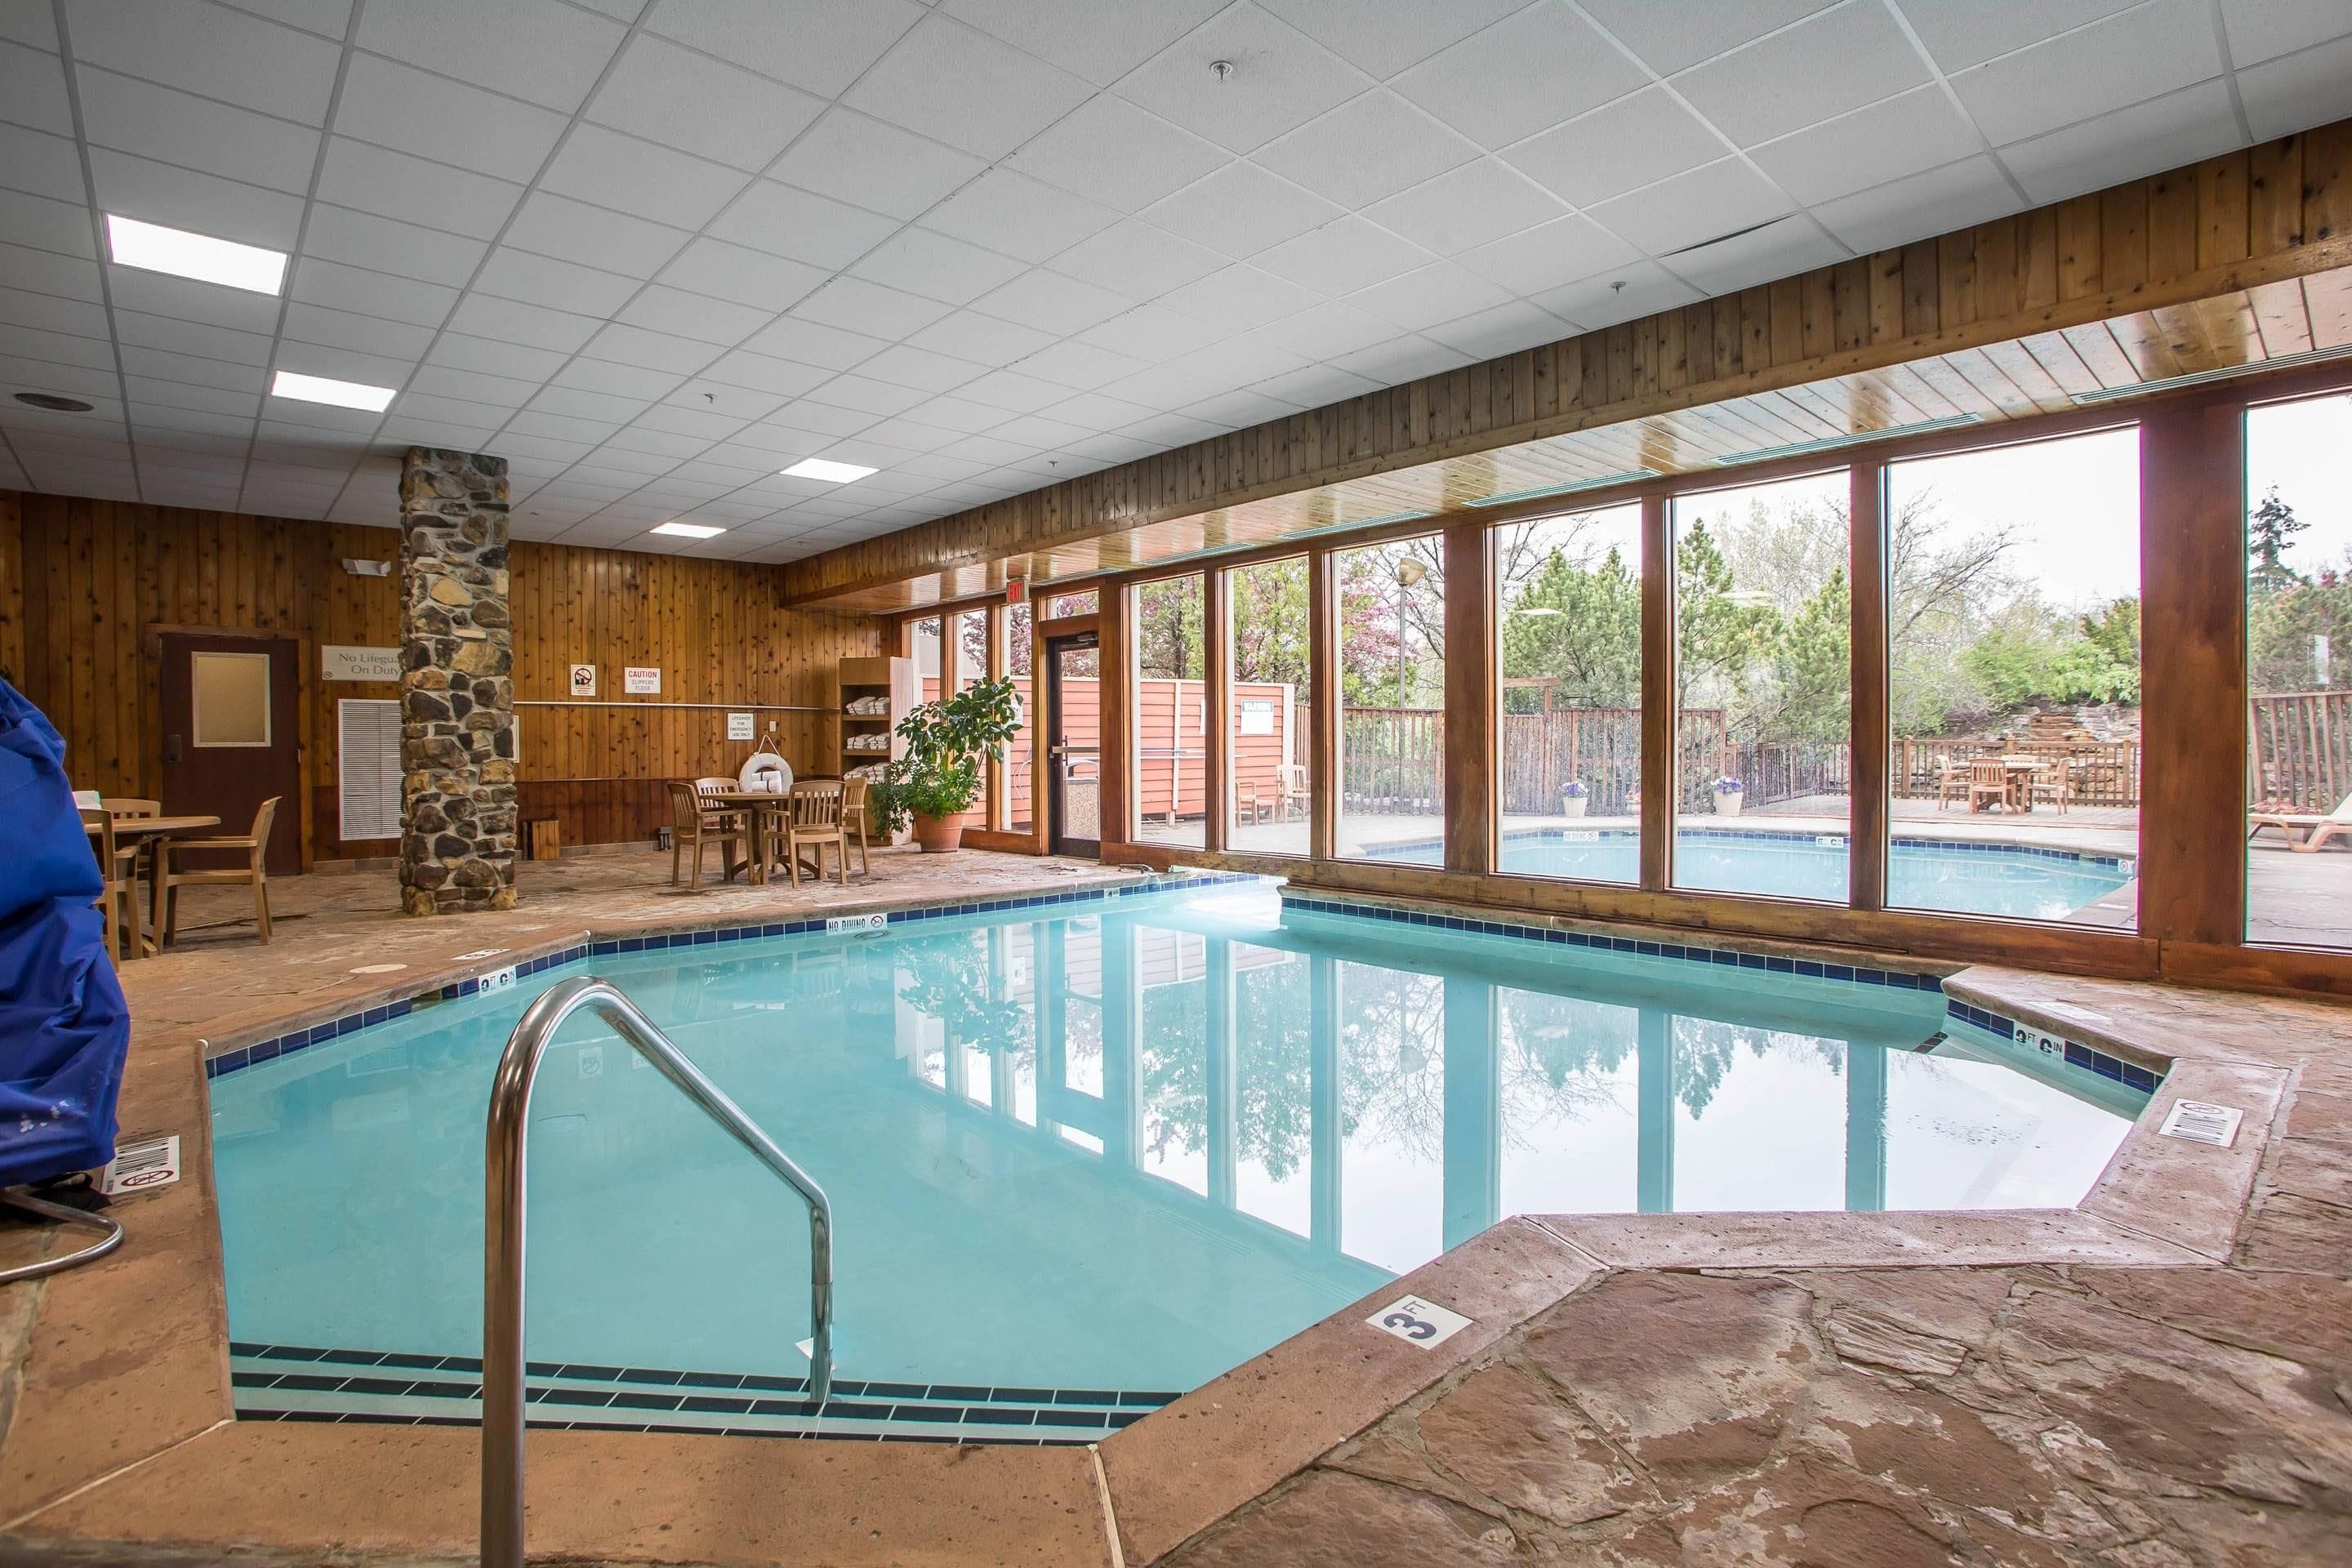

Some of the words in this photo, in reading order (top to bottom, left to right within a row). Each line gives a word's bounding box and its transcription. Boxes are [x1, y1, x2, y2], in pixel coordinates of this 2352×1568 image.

[1009, 581, 1022, 602] EXIT
[339, 653, 357, 663] No
[360, 653, 399, 666] Lifegua
[351, 665, 369, 675] On
[373, 666, 400, 675] Duty
[628, 670, 657, 679] CAUTION
[828, 920, 839, 933] NO
[2027, 1031, 2036, 1043] FT
[2053, 1041, 2063, 1054] IN
[1401, 1300, 1427, 1316] FT
[1383, 1312, 1437, 1340] 3
